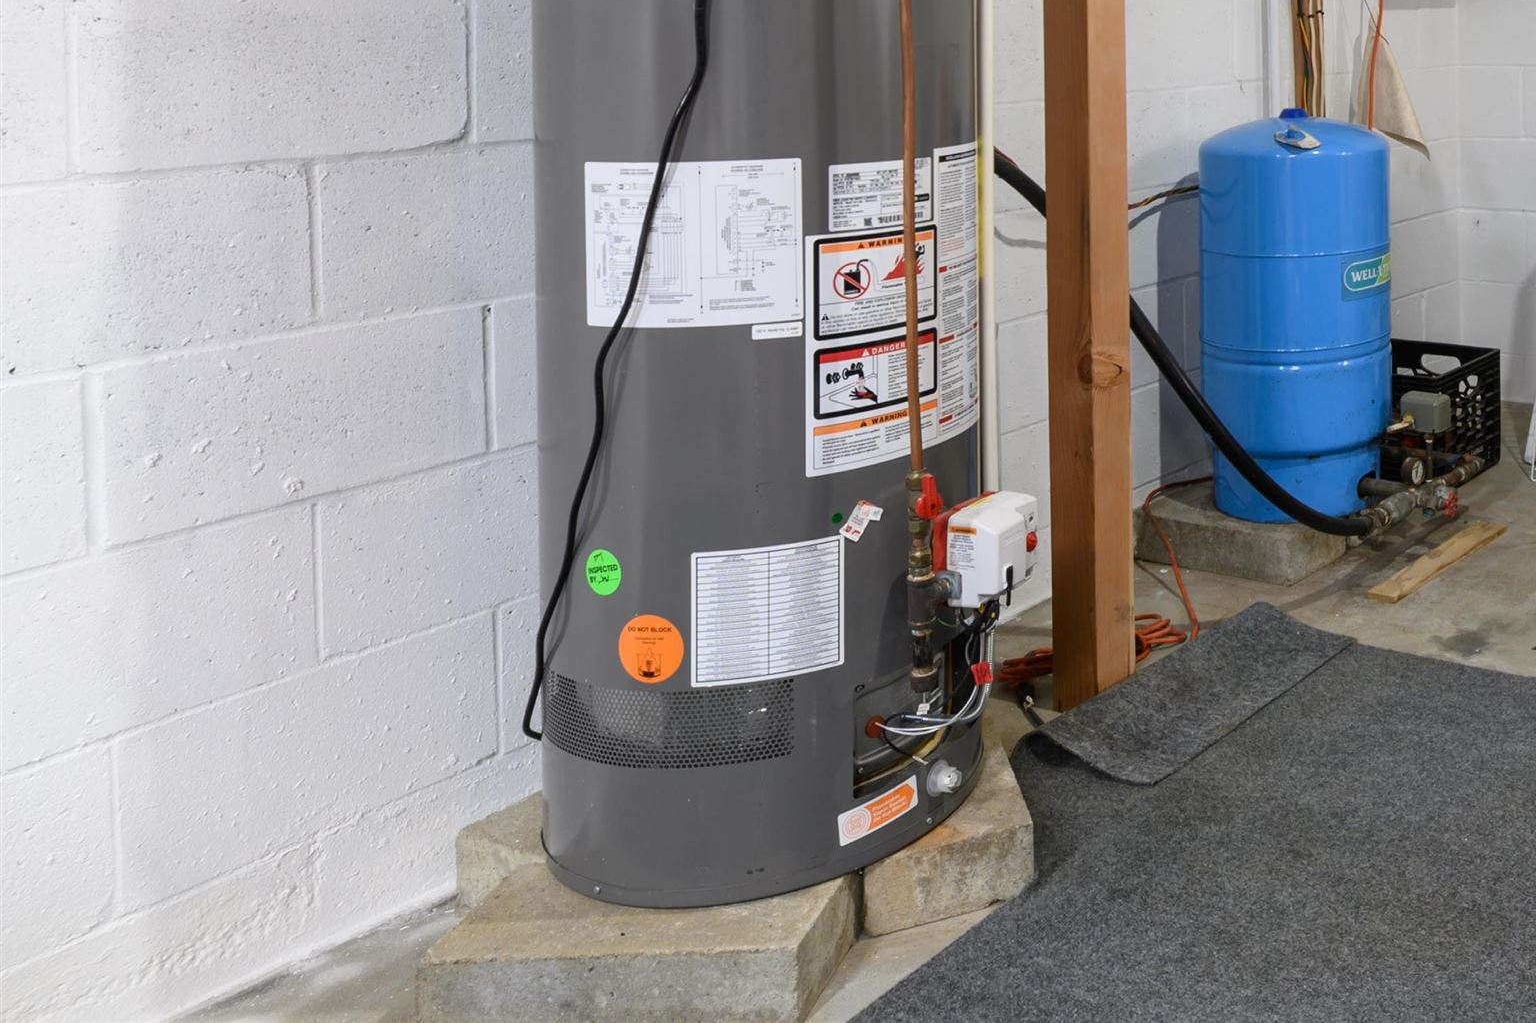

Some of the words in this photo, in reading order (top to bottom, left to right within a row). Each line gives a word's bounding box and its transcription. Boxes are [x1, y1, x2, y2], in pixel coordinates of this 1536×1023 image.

[869, 237, 903, 248] WARNIN
[871, 343, 906, 355] DANGER
[871, 410, 908, 425] WARNING
[588, 564, 618, 575] INSPECTED
